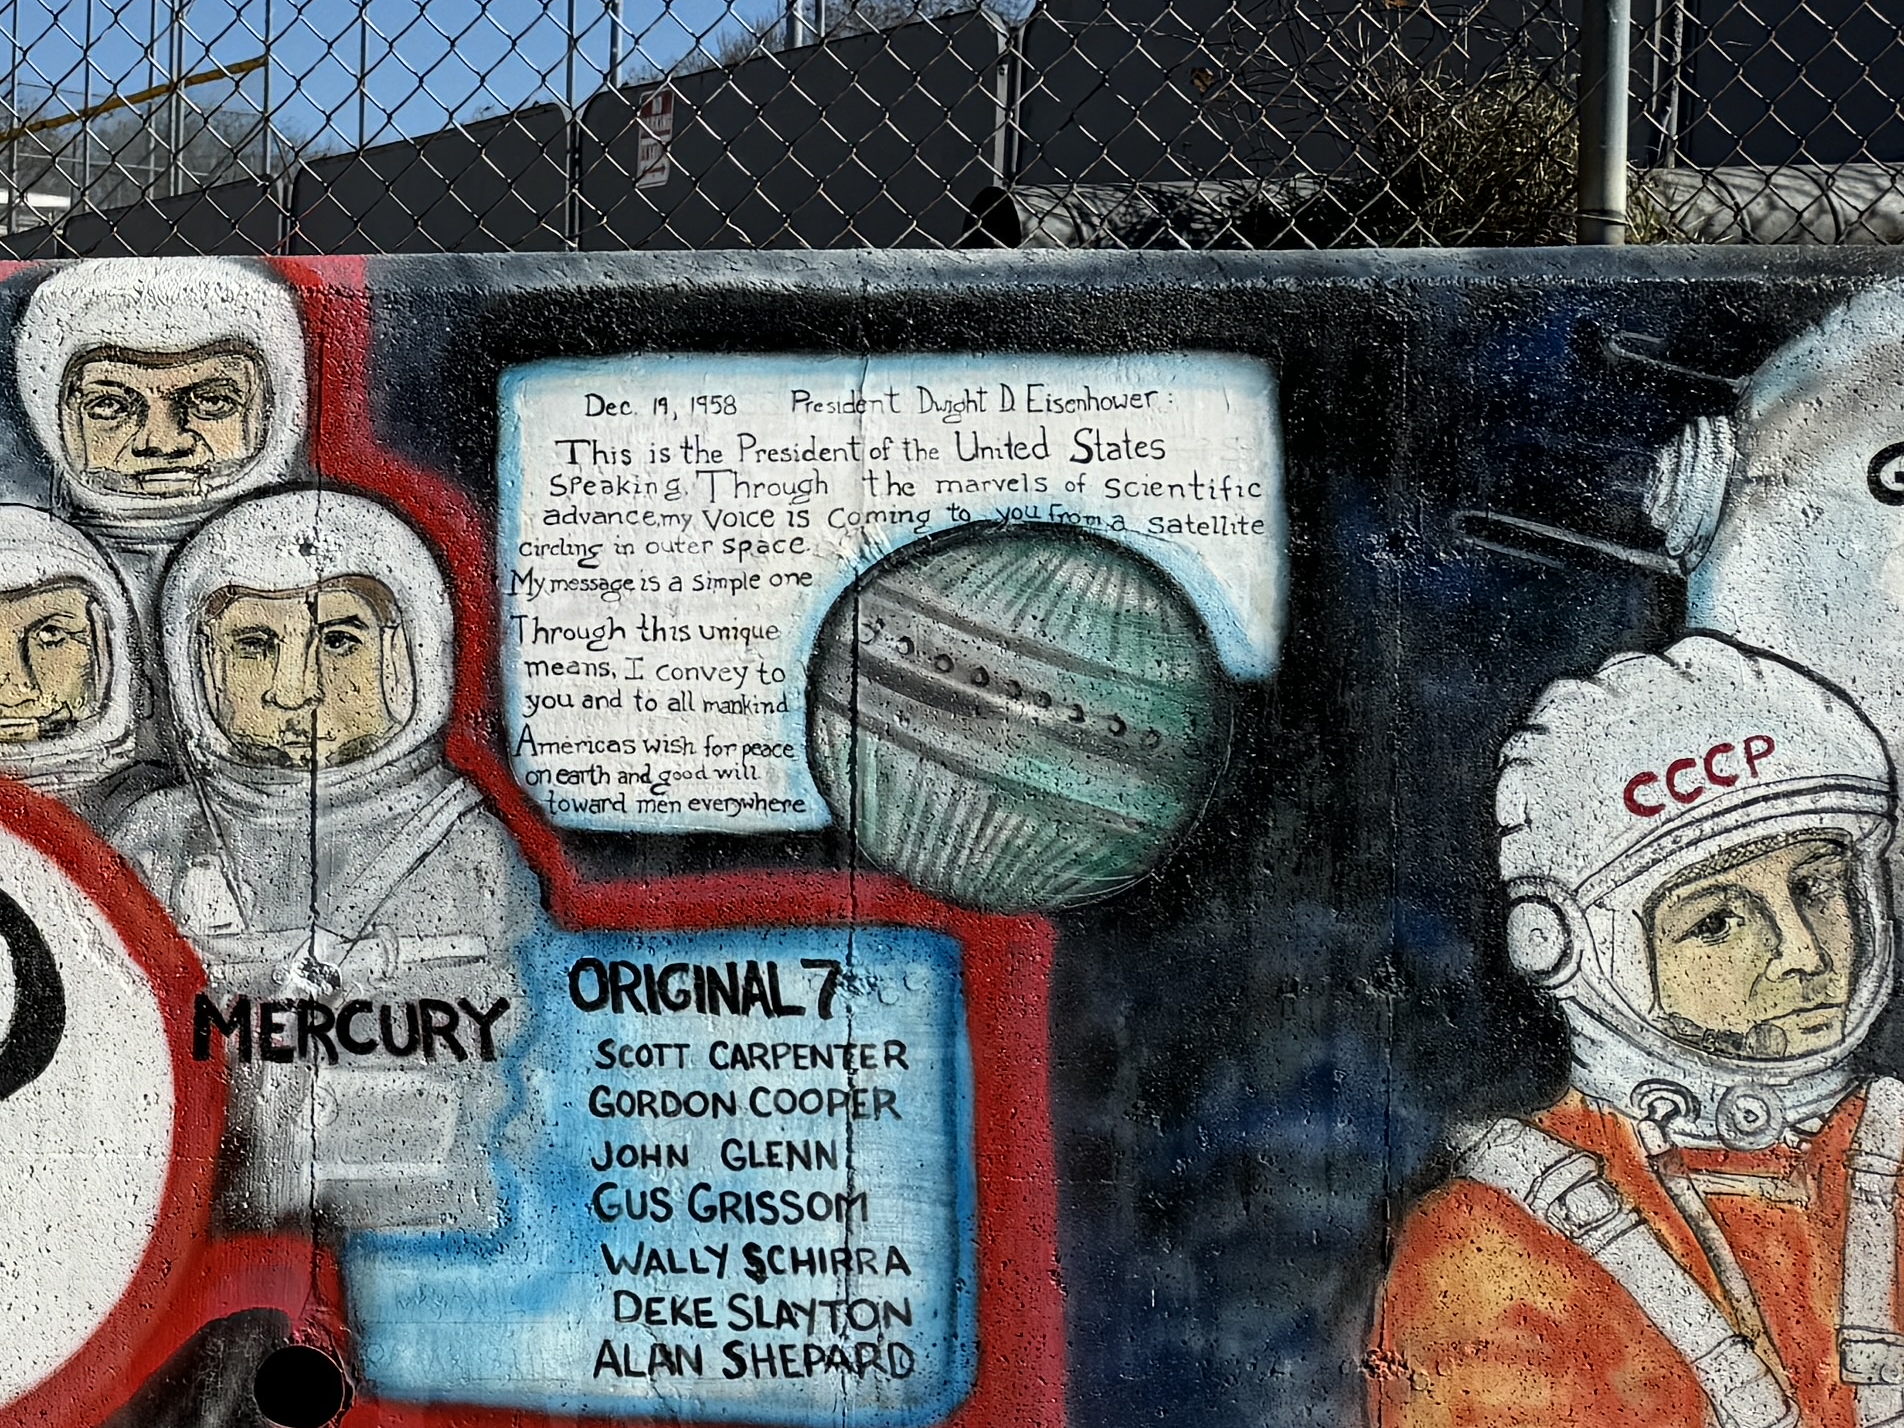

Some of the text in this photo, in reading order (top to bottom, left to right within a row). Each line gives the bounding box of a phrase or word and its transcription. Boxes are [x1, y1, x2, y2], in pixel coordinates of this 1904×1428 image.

[584, 385, 989, 423] Dec. 19, 1958 President Dwight
[555, 425, 1166, 466] This is the President of the United States
[696, 468, 1087, 505] Through the marvels of
[788, 504, 810, 528] is
[947, 502, 971, 523] to
[995, 504, 1041, 530] you
[1110, 515, 1126, 532] a
[519, 535, 714, 569] circling in outer
[508, 566, 813, 602] My message is a simple one
[510, 613, 781, 652] Through this unique
[524, 657, 786, 689] means, I convey to
[523, 689, 790, 717] you and to all mankind
[512, 723, 794, 764] Americas wish for peace
[525, 762, 758, 796] on earth and good will
[547, 790, 807, 817] toward men everywhere
[568, 957, 842, 1021] ORIGINAL 7
[193, 993, 509, 1064] MERCURY
[595, 1039, 909, 1072] SCOTT CARPENTER
[589, 1086, 903, 1121] GORDON COOPER
[592, 1138, 838, 1171] JOHN GLENN
[592, 1182, 868, 1226] GUS GRISSOM
[600, 1242, 912, 1285] WALLY SCHIRRA
[614, 1290, 913, 1334] DEKE SLAYTON
[593, 1340, 915, 1380] ALAN SHEPARD
